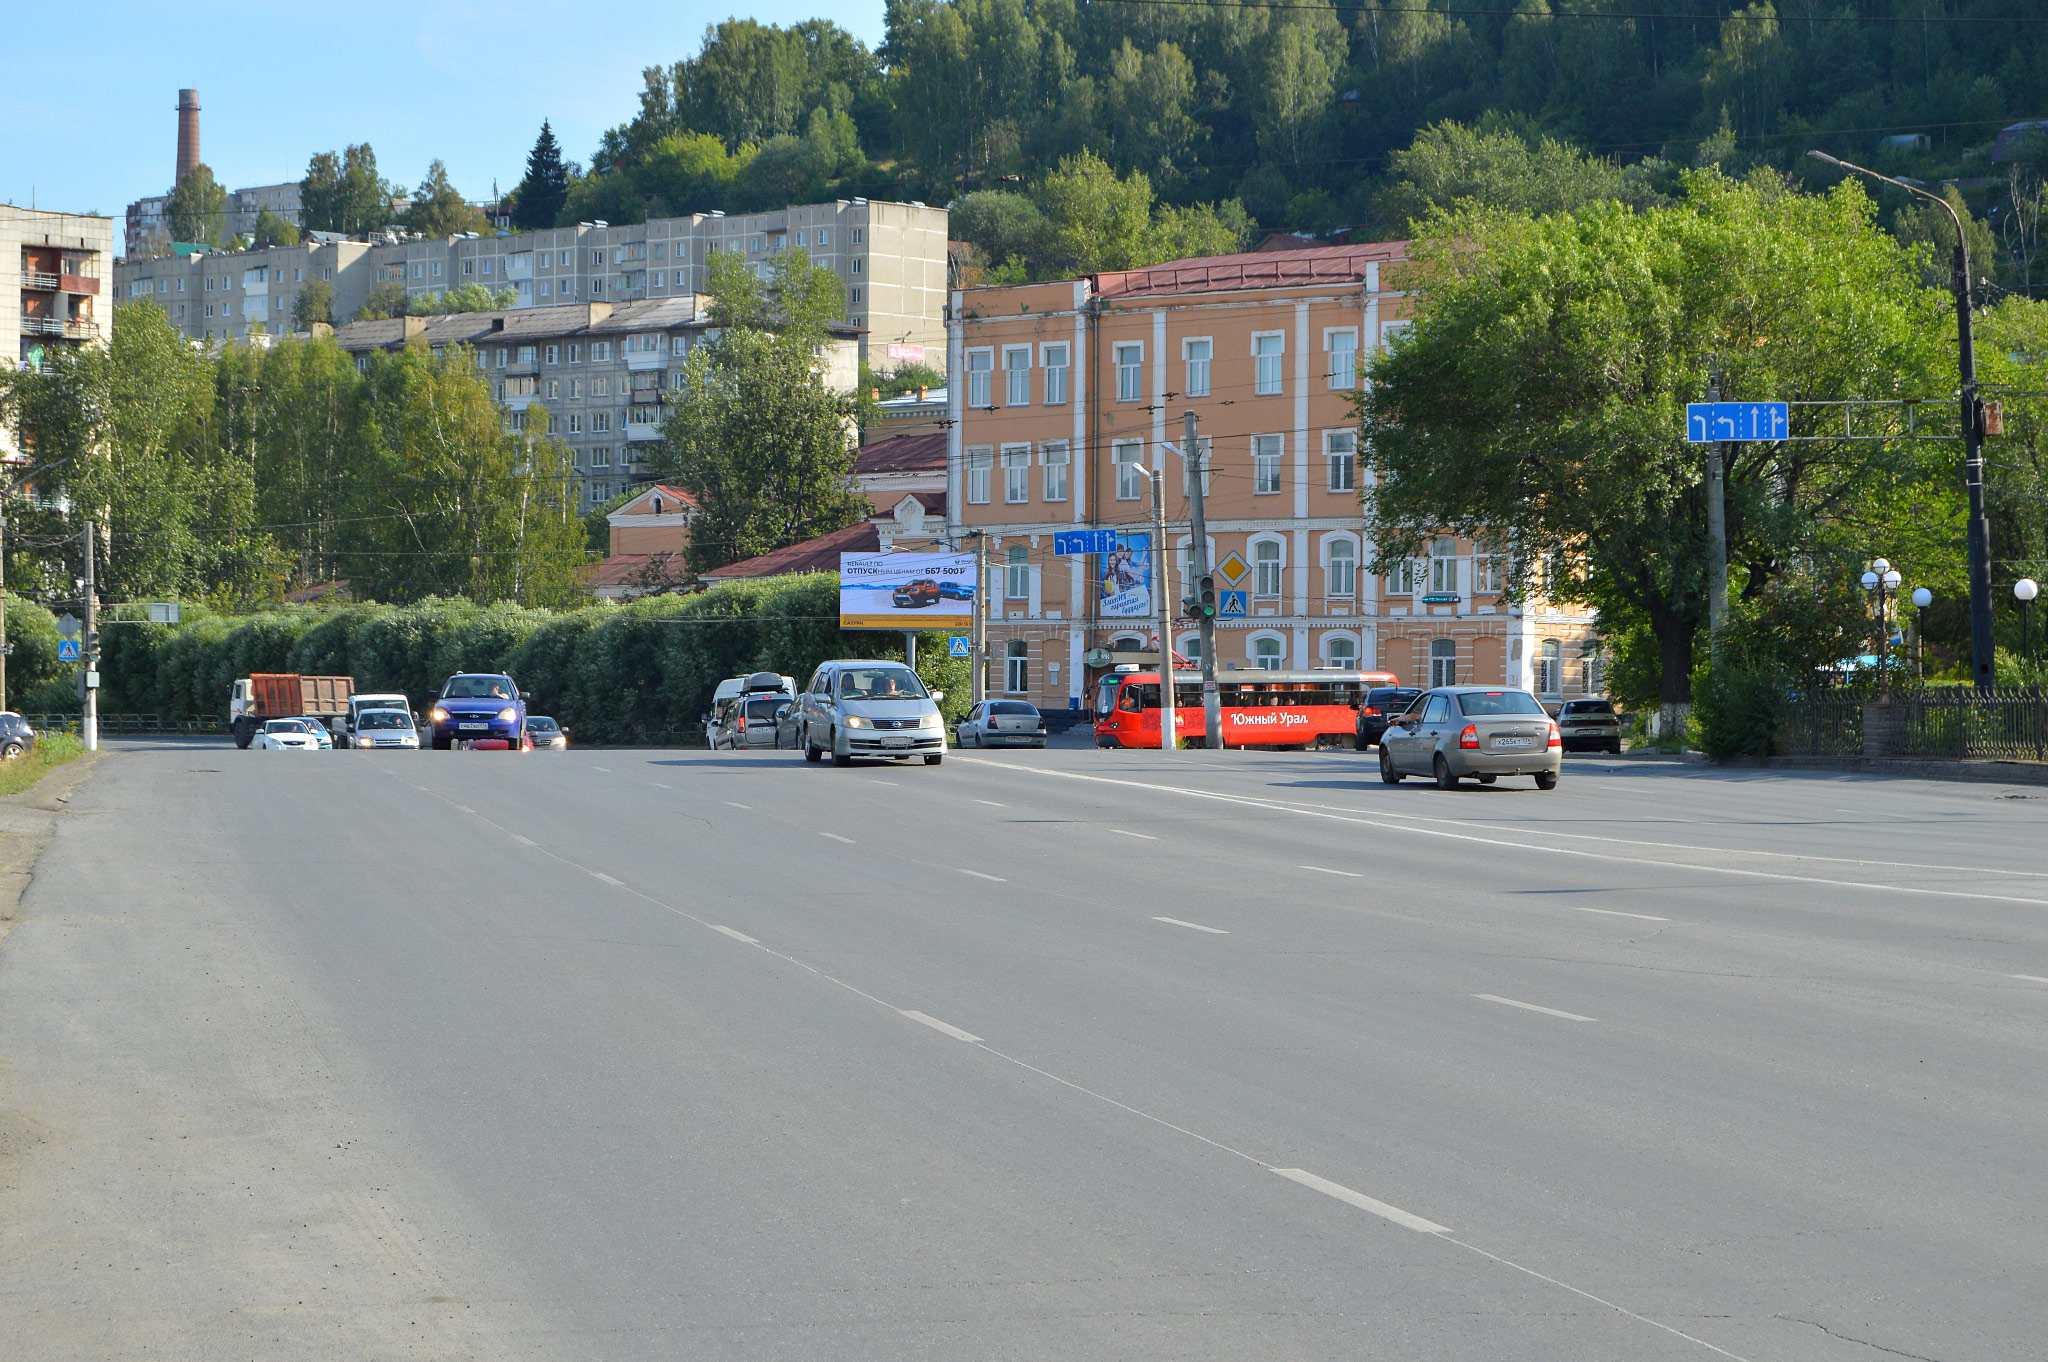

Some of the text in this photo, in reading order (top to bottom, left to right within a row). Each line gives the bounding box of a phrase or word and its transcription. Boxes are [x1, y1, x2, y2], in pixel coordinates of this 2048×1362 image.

[925, 567, 941, 575] 667
[942, 567, 959, 575] 500
[1110, 596, 1139, 611] гарантия
[1121, 599, 1149, 615] будущего!
[1230, 711, 1309, 728] Южный Урал
